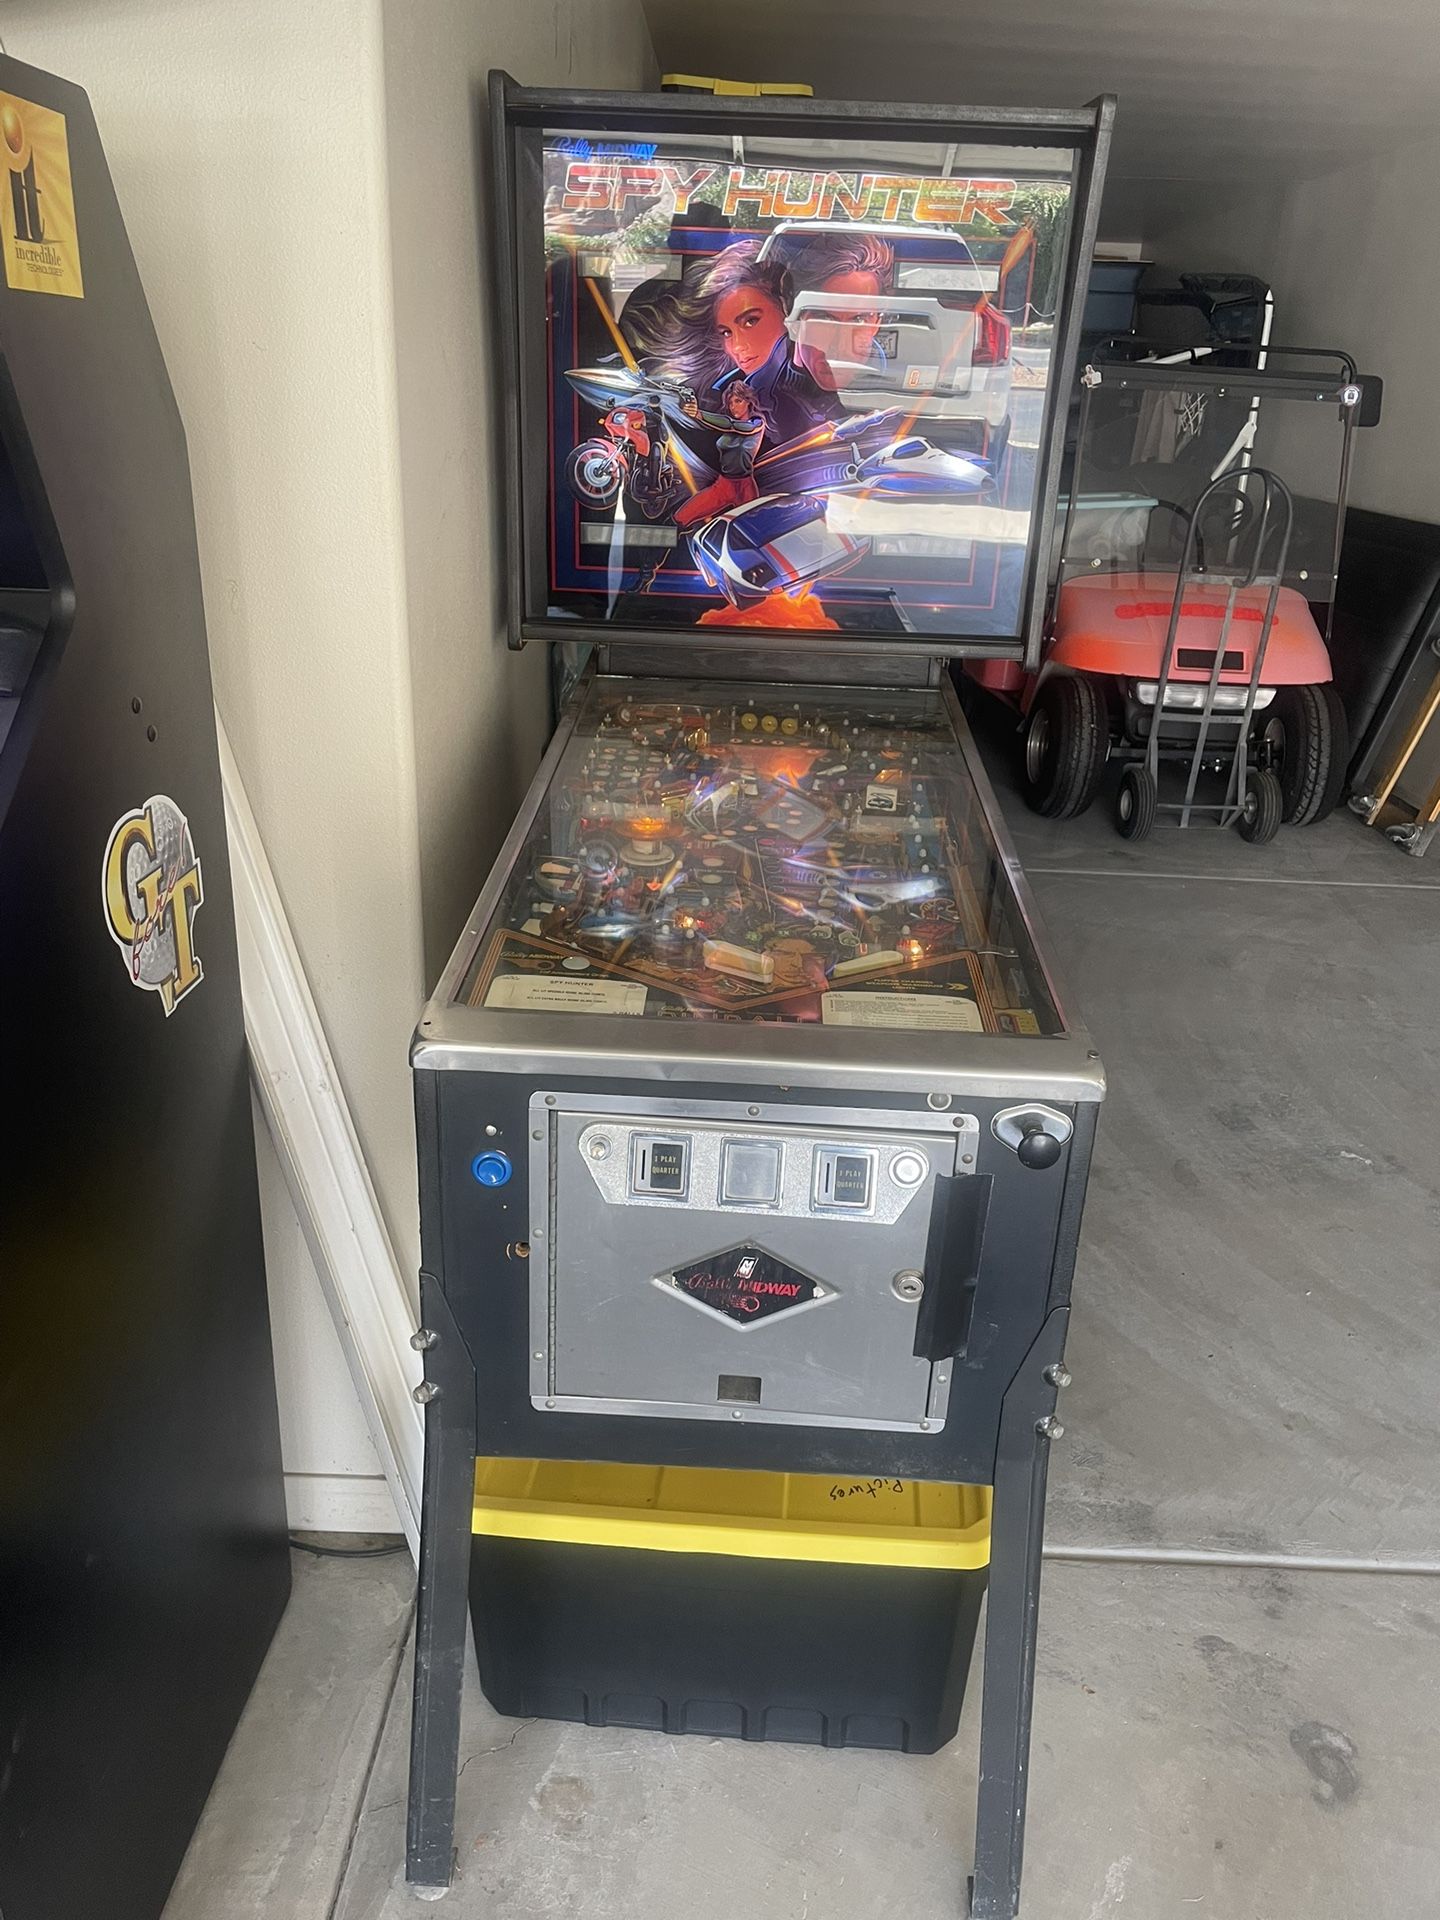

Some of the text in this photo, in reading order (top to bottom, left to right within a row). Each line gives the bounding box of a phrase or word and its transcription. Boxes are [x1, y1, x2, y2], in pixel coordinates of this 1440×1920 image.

[563, 162, 1017, 225] SPY HUNTER
[15, 241, 61, 266] incredible
[660, 1155, 677, 1163] PLAY
[652, 1166, 679, 1175] QUARTER
[737, 1279, 801, 1297] MIDWAY
[829, 1478, 903, 1501] Pictures
